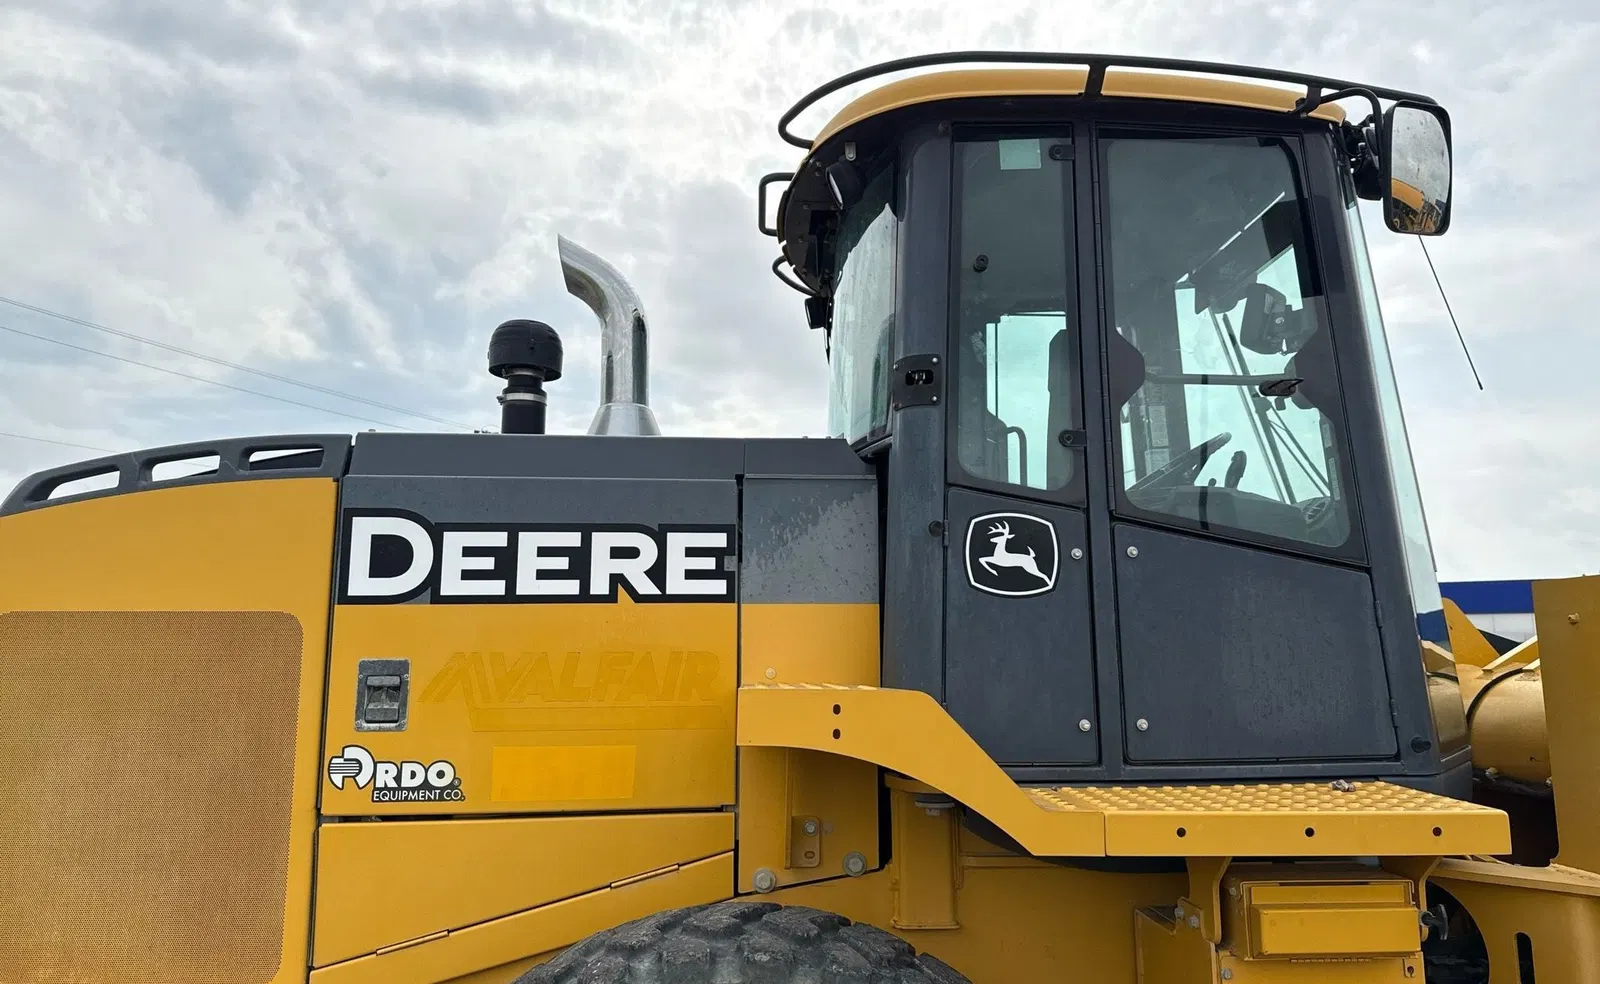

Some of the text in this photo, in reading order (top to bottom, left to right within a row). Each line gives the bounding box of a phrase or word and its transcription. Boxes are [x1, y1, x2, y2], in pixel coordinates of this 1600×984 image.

[347, 516, 728, 596] DEERE
[373, 789, 465, 801] EQUIPMENT CO.
